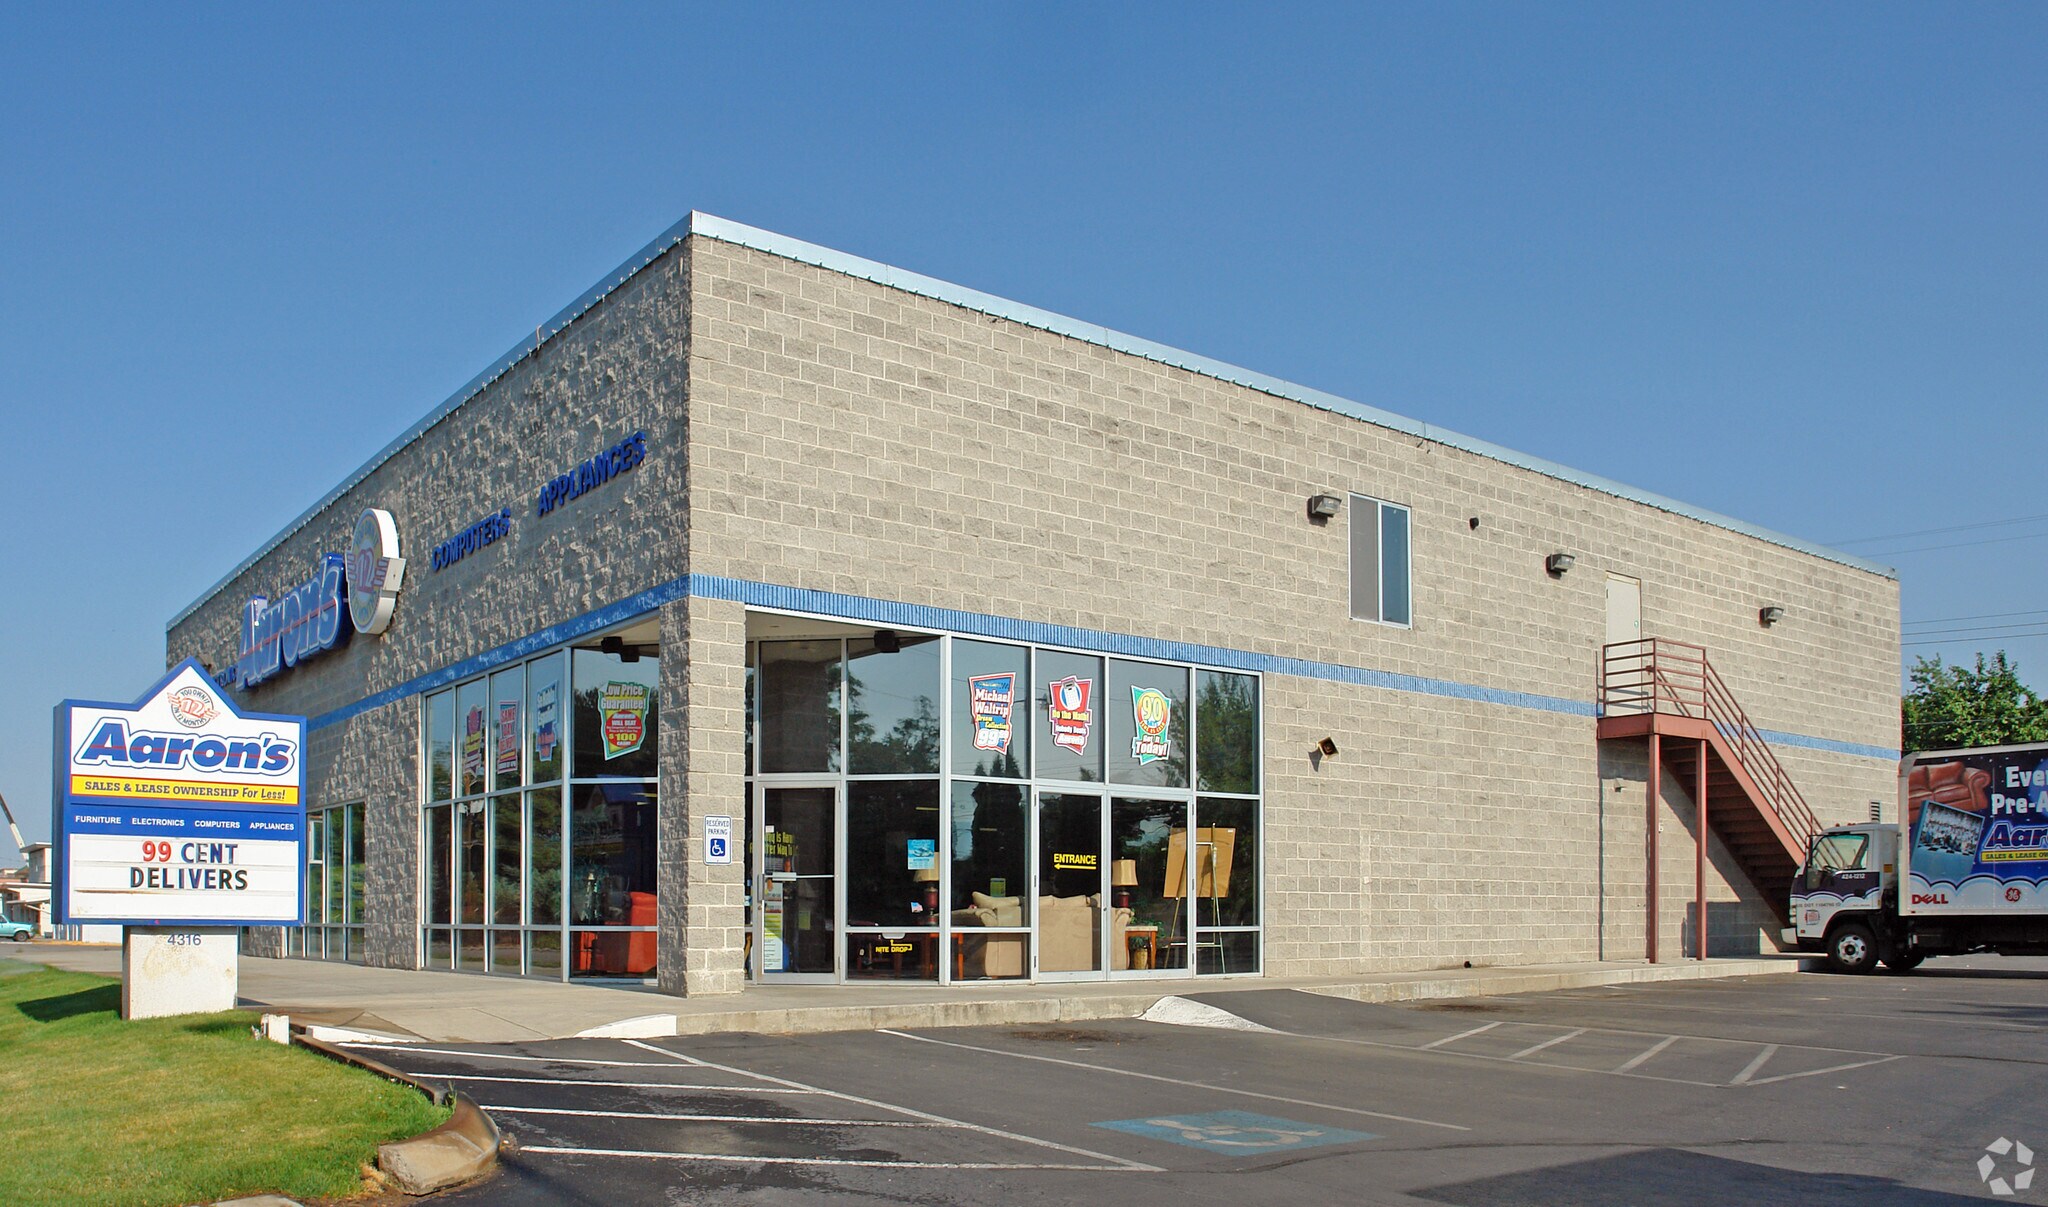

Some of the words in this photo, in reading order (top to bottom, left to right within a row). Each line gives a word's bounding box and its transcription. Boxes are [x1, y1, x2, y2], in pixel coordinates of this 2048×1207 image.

[431, 507, 511, 572] COMPUTERS
[537, 430, 647, 517] APPLIANCES
[180, 689, 192, 697] YOU
[192, 689, 206, 700] OWN
[621, 684, 643, 696] Price
[975, 688, 1011, 703] Michael
[975, 701, 1009, 718] Waltrip
[1061, 710, 1072, 719] the
[1142, 695, 1163, 722] 90
[79, 721, 293, 772] Aaron's
[1136, 741, 1168, 756] Today!
[2006, 765, 2048, 788] Eve
[85, 781, 121, 791] SALES
[123, 783, 132, 792] &
[135, 784, 170, 794] LEASE
[173, 786, 240, 797] OWNERSHIP
[242, 787, 259, 798] For
[261, 788, 286, 800] Less!
[75, 815, 122, 824] FURNITURE
[131, 817, 185, 827] ELECTRONICS
[194, 820, 241, 829] COMPUTERS
[249, 822, 295, 831] APPLIANCES
[706, 819, 730, 828] RESERVED
[142, 840, 172, 863] 99
[181, 842, 239, 864] CENT
[1053, 853, 1097, 865] ENTRANCE
[130, 866, 248, 891] DELIVERS
[1912, 893, 1949, 905] DELL
[167, 933, 202, 946] 4316
